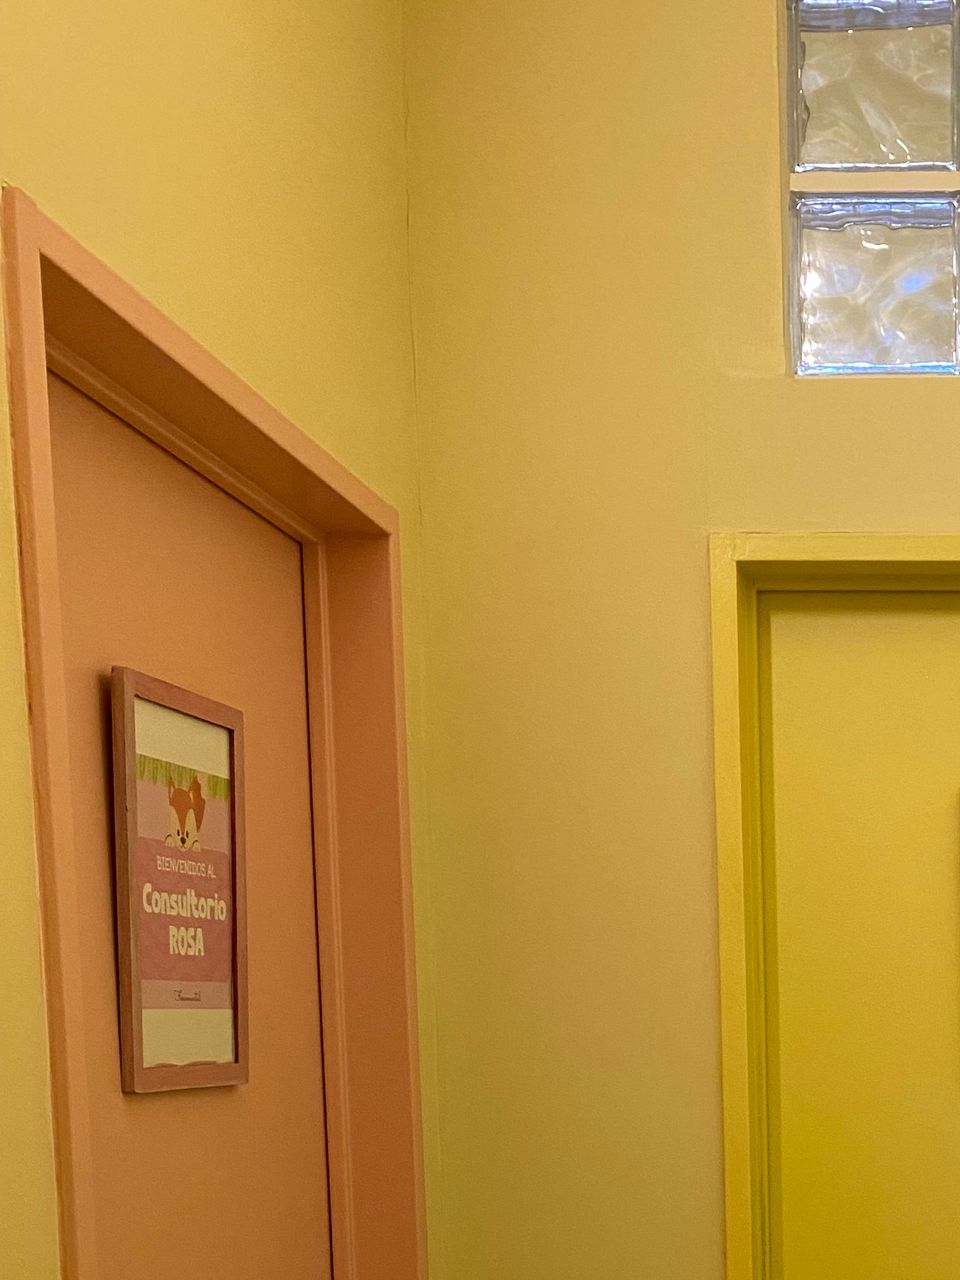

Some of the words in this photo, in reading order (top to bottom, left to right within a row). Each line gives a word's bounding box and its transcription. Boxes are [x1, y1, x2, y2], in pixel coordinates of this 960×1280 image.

[156, 855, 206, 877] BIENVENIDOS
[207, 864, 216, 878] AL
[143, 883, 226, 920] Consultorio
[169, 925, 204, 956] ROSA
